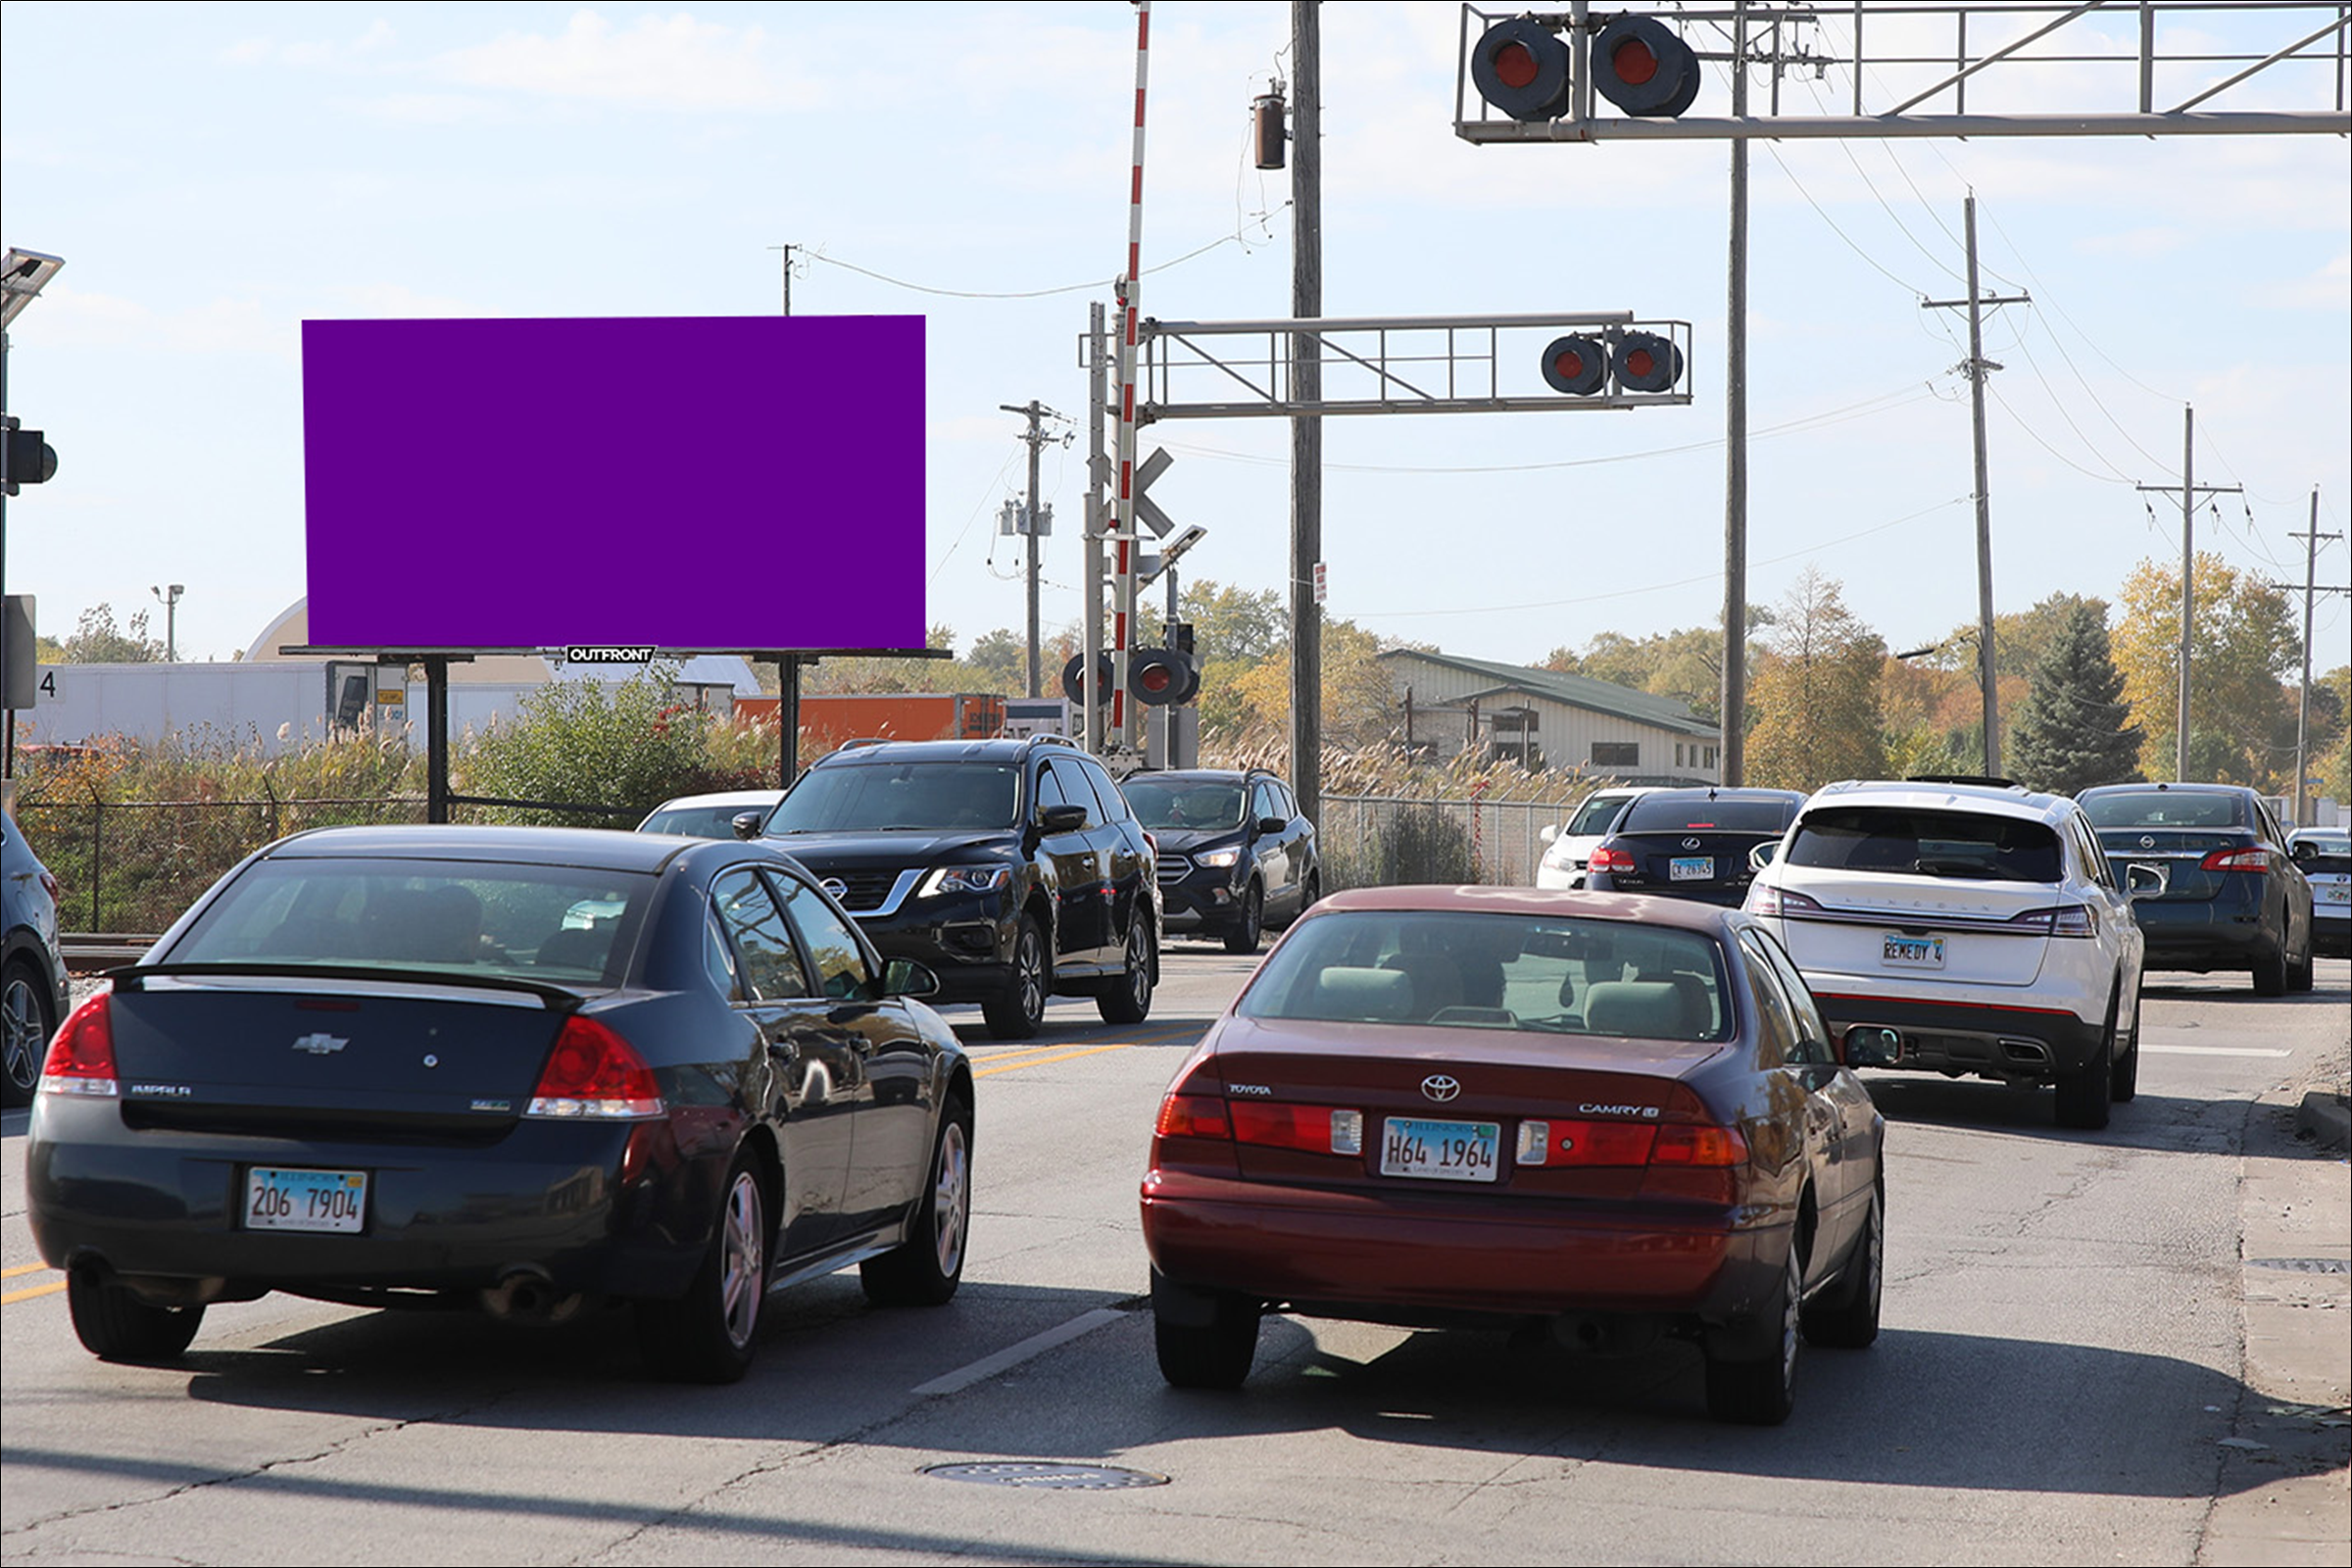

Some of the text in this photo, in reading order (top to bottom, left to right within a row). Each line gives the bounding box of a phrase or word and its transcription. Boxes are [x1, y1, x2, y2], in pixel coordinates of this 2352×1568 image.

[570, 648, 652, 661] OUTFRONT
[40, 671, 56, 698] 4
[1884, 942, 1942, 962] REMEDY 4
[131, 1084, 192, 1096] IMPALA
[1229, 1084, 1271, 1095] TOYOTA
[1579, 1102, 1642, 1115] CAMRY
[1388, 1135, 1492, 1168] H64 1964
[252, 1186, 358, 1220] 206 7904
